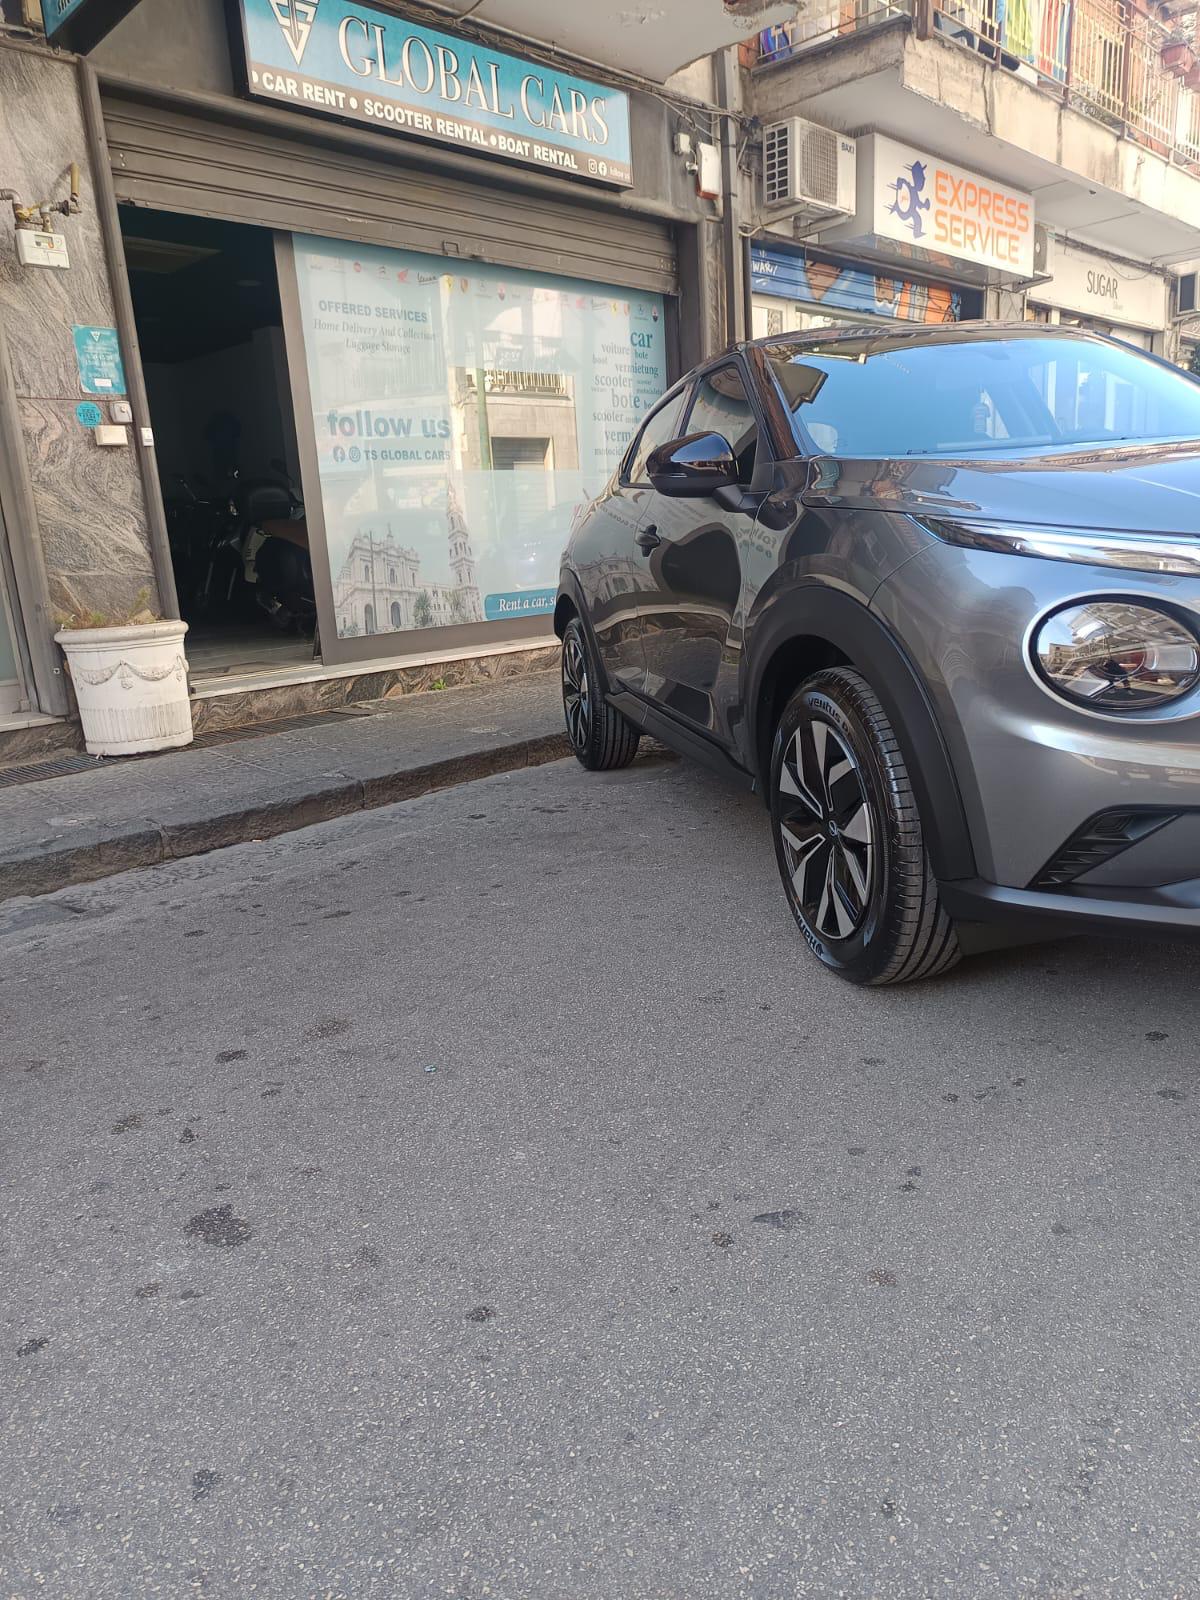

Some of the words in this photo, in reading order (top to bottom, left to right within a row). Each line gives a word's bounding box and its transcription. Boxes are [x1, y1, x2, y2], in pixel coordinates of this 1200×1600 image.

[262, 71, 299, 97] CAR
[302, 81, 346, 110] RENT
[338, 15, 514, 119] GLOBAL
[520, 74, 609, 146] CARS
[363, 98, 433, 133] SCOOTER
[435, 117, 488, 148] RENTAL
[498, 135, 531, 157] BOAT
[533, 143, 578, 170] RENTAL
[934, 169, 1030, 233] EXPRESS
[934, 211, 1021, 265] SERVICE
[1087, 270, 1118, 299] SUGAR
[319, 300, 371, 317] OFFERED
[375, 306, 428, 323] SERVICES
[313, 319, 340, 332] Home
[342, 321, 377, 338] Delivery
[630, 331, 654, 348] car
[614, 362, 659, 377] vermietung
[611, 388, 640, 409] bote
[421, 418, 451, 438] us
[364, 450, 378, 461] TS
[380, 450, 422, 461] GLOBAL
[424, 450, 451, 461] CARS
[499, 598, 521, 612] Rent
[523, 598, 529, 609] a
[531, 596, 548, 609] car,
